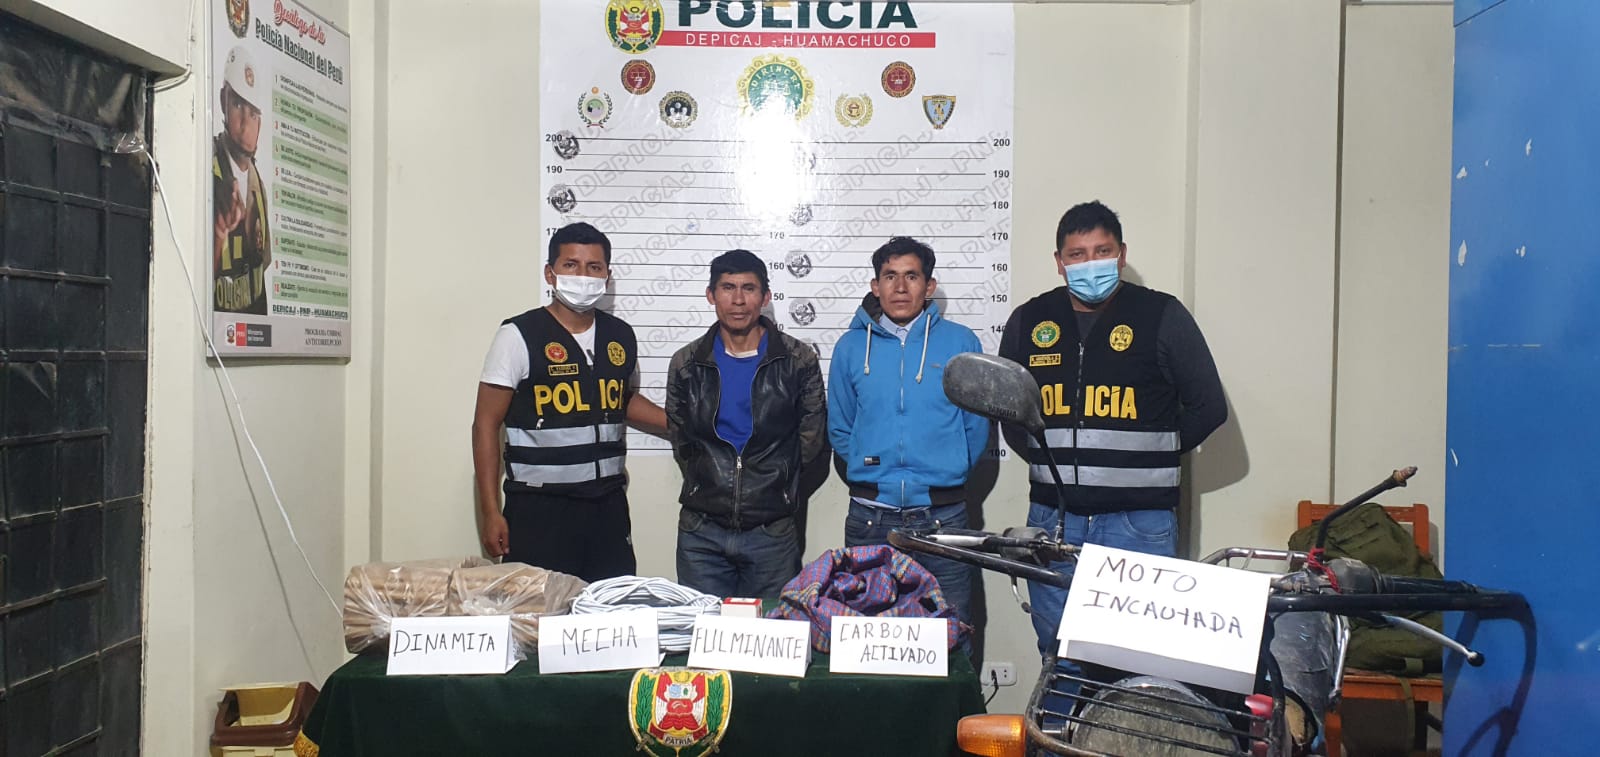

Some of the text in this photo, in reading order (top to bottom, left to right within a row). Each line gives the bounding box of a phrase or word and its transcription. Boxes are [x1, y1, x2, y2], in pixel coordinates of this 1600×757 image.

[686, 34, 762, 46] DEPICAJ
[783, 35, 911, 47] HUAMACHUCO
[256, 17, 283, 49] Policía
[284, 34, 315, 68] Nacional
[316, 54, 327, 75] del
[545, 134, 563, 142] 200
[993, 138, 1010, 147] 200
[546, 165, 563, 173] 190
[993, 170, 1010, 178] 190
[992, 201, 1009, 209] 180
[769, 231, 785, 239] 170
[992, 232, 1008, 240] 170
[769, 262, 784, 270] 160
[991, 263, 1008, 271] 160
[773, 292, 784, 301] 50
[991, 294, 1008, 303] 150
[273, 304, 297, 315] DEPICAJ
[314, 309, 348, 320] HUAMACHUCO
[1041, 384, 1071, 416] OL
[990, 449, 1006, 457] 100
[1096, 556, 1197, 593] MOTO
[1083, 589, 1243, 639] INCAUTADA
[839, 623, 921, 642] CARBON
[393, 630, 495, 657] DINAMITA
[562, 626, 638, 656] MECHA
[694, 627, 805, 661] FULMINANTE
[860, 644, 937, 665] ACTIVADO
[664, 735, 692, 745] PATRIA
